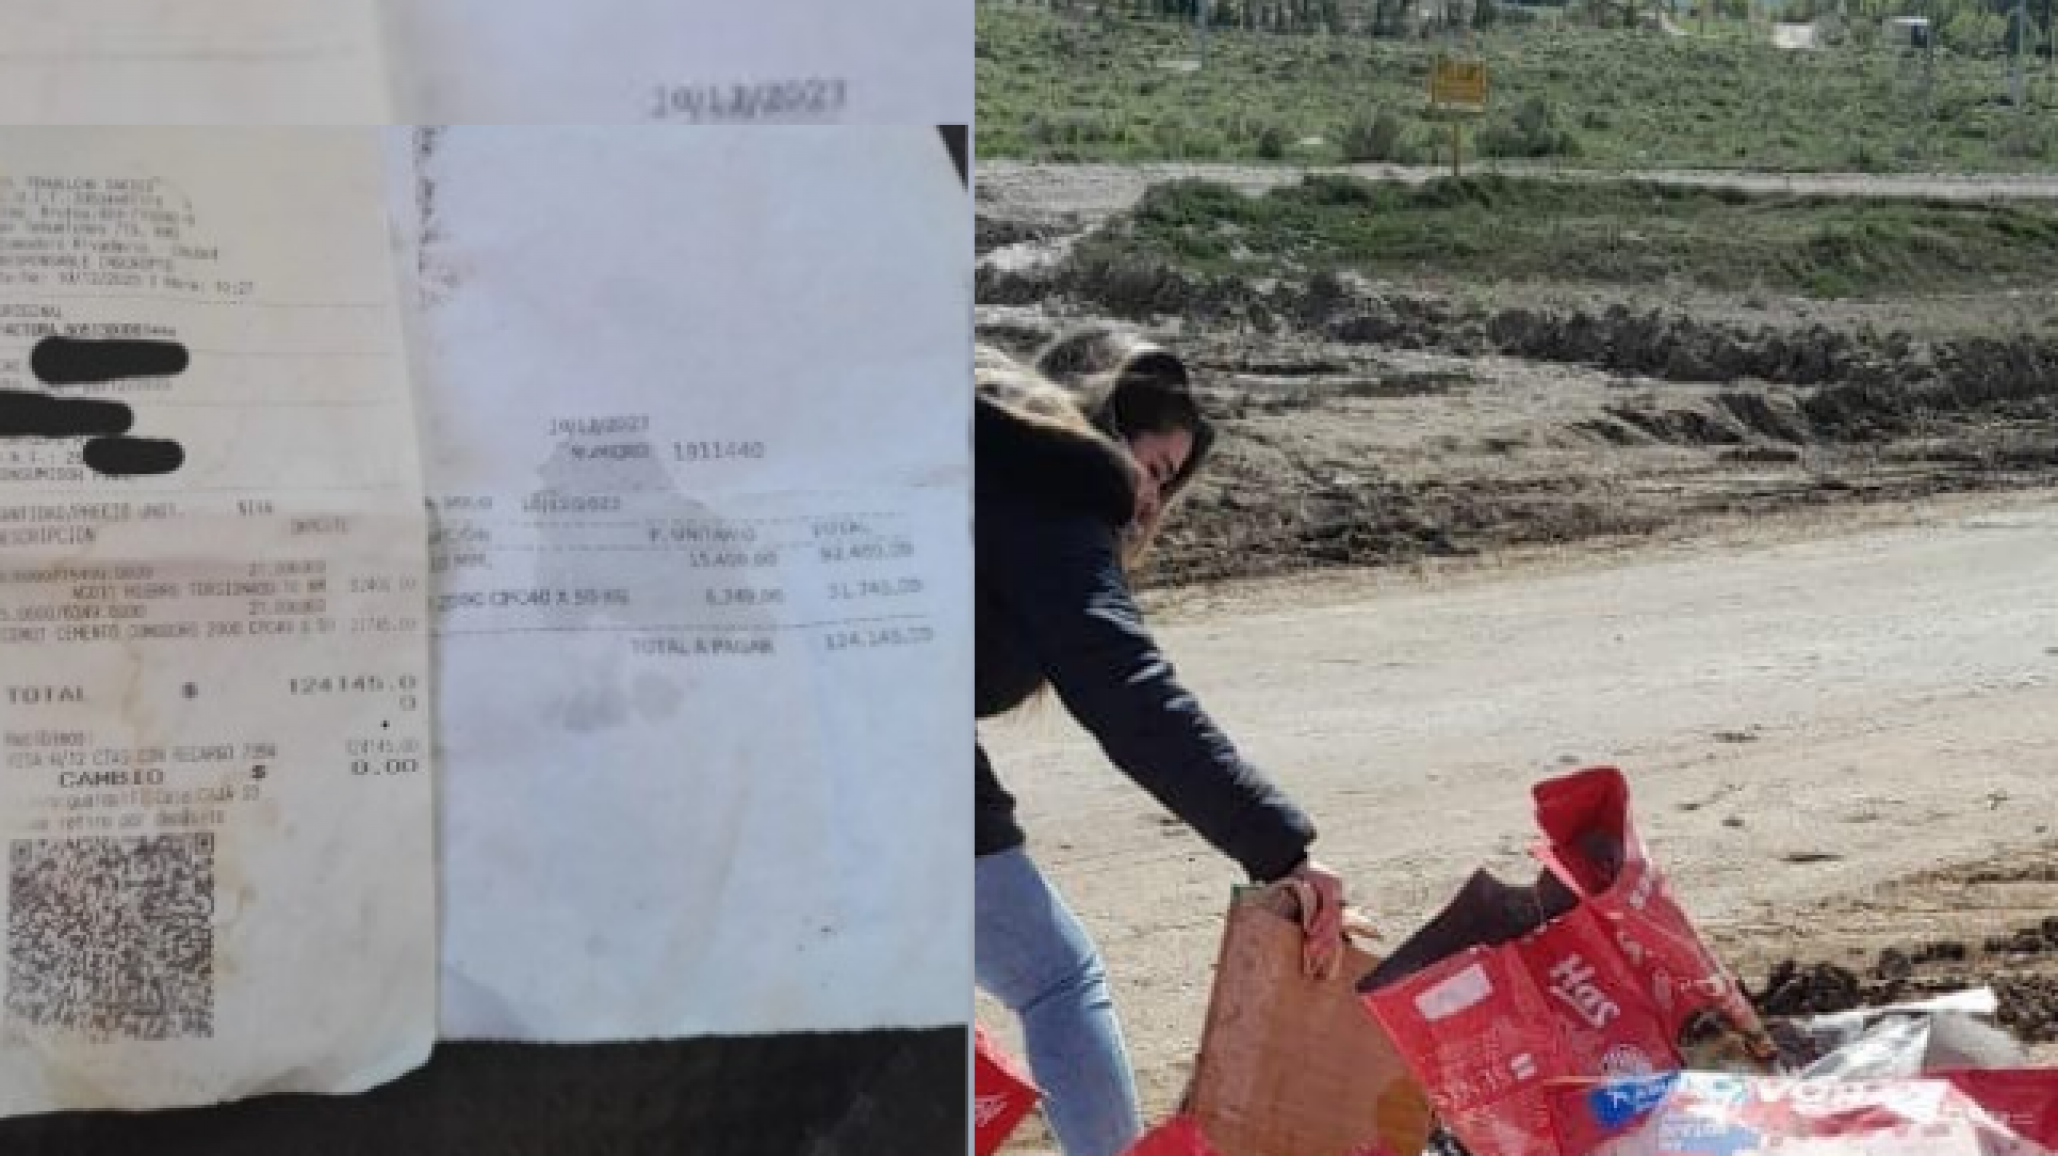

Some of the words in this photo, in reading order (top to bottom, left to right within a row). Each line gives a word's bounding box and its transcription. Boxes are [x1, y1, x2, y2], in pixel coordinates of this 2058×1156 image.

[7, 685, 85, 704] TOTAL
[350, 758, 419, 776] 0.00
[59, 768, 164, 788] CAMBIO
